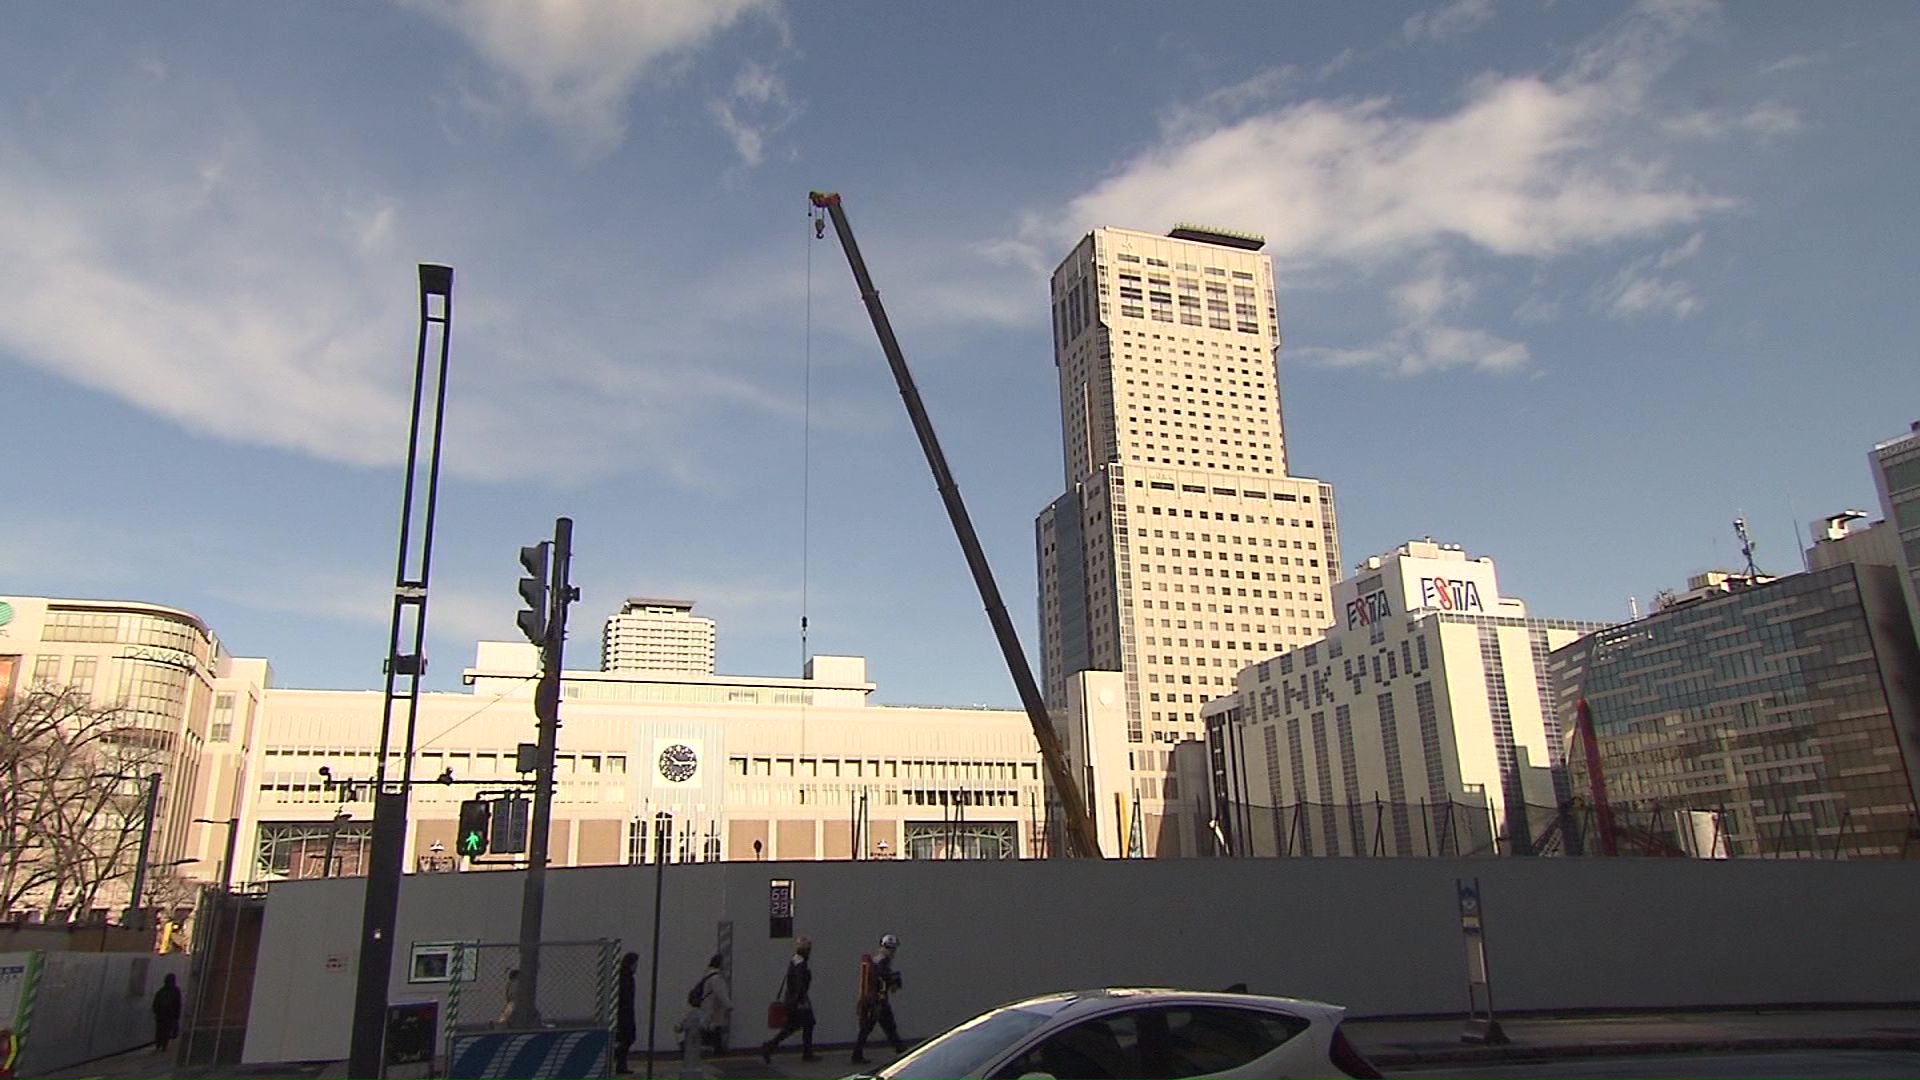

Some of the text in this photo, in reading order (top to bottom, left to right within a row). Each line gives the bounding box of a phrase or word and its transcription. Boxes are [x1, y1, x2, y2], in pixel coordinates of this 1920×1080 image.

[1346, 589, 1392, 632] ESTA
[1420, 576, 1484, 613] ESTA
[124, 646, 195, 667] DAIMAR
[1343, 634, 1429, 696] YOU
